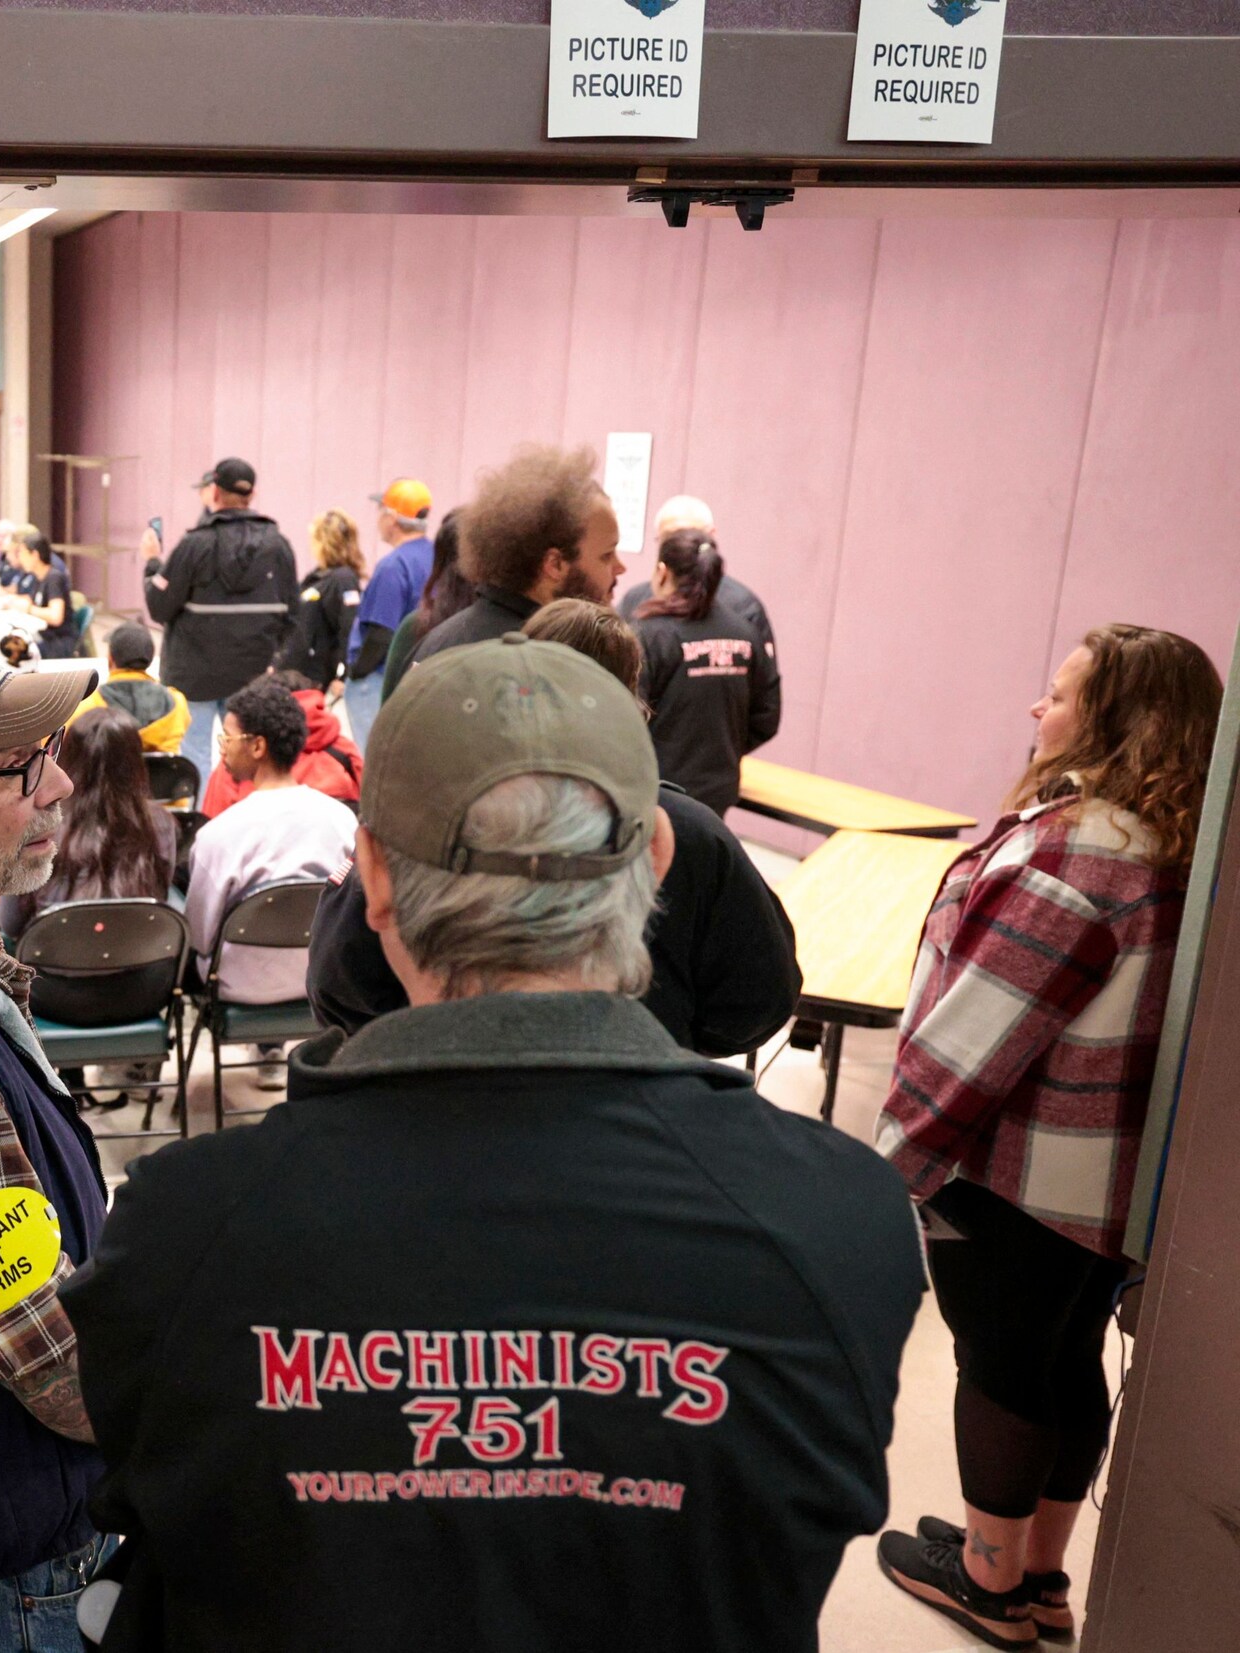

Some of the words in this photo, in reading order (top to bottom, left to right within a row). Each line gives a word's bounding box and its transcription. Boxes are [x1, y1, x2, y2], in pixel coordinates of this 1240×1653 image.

[568, 37, 664, 63] PICTURE
[669, 39, 688, 63] ID
[873, 43, 962, 69] PICTURE
[968, 46, 987, 71] ID
[572, 73, 683, 100] REQUIRED
[874, 79, 980, 105] REQUIRED
[250, 1325, 730, 1426] MACHINISTS
[401, 1396, 564, 1467] 751
[286, 1467, 686, 1512] YOURPOWERINSIDE.COM
